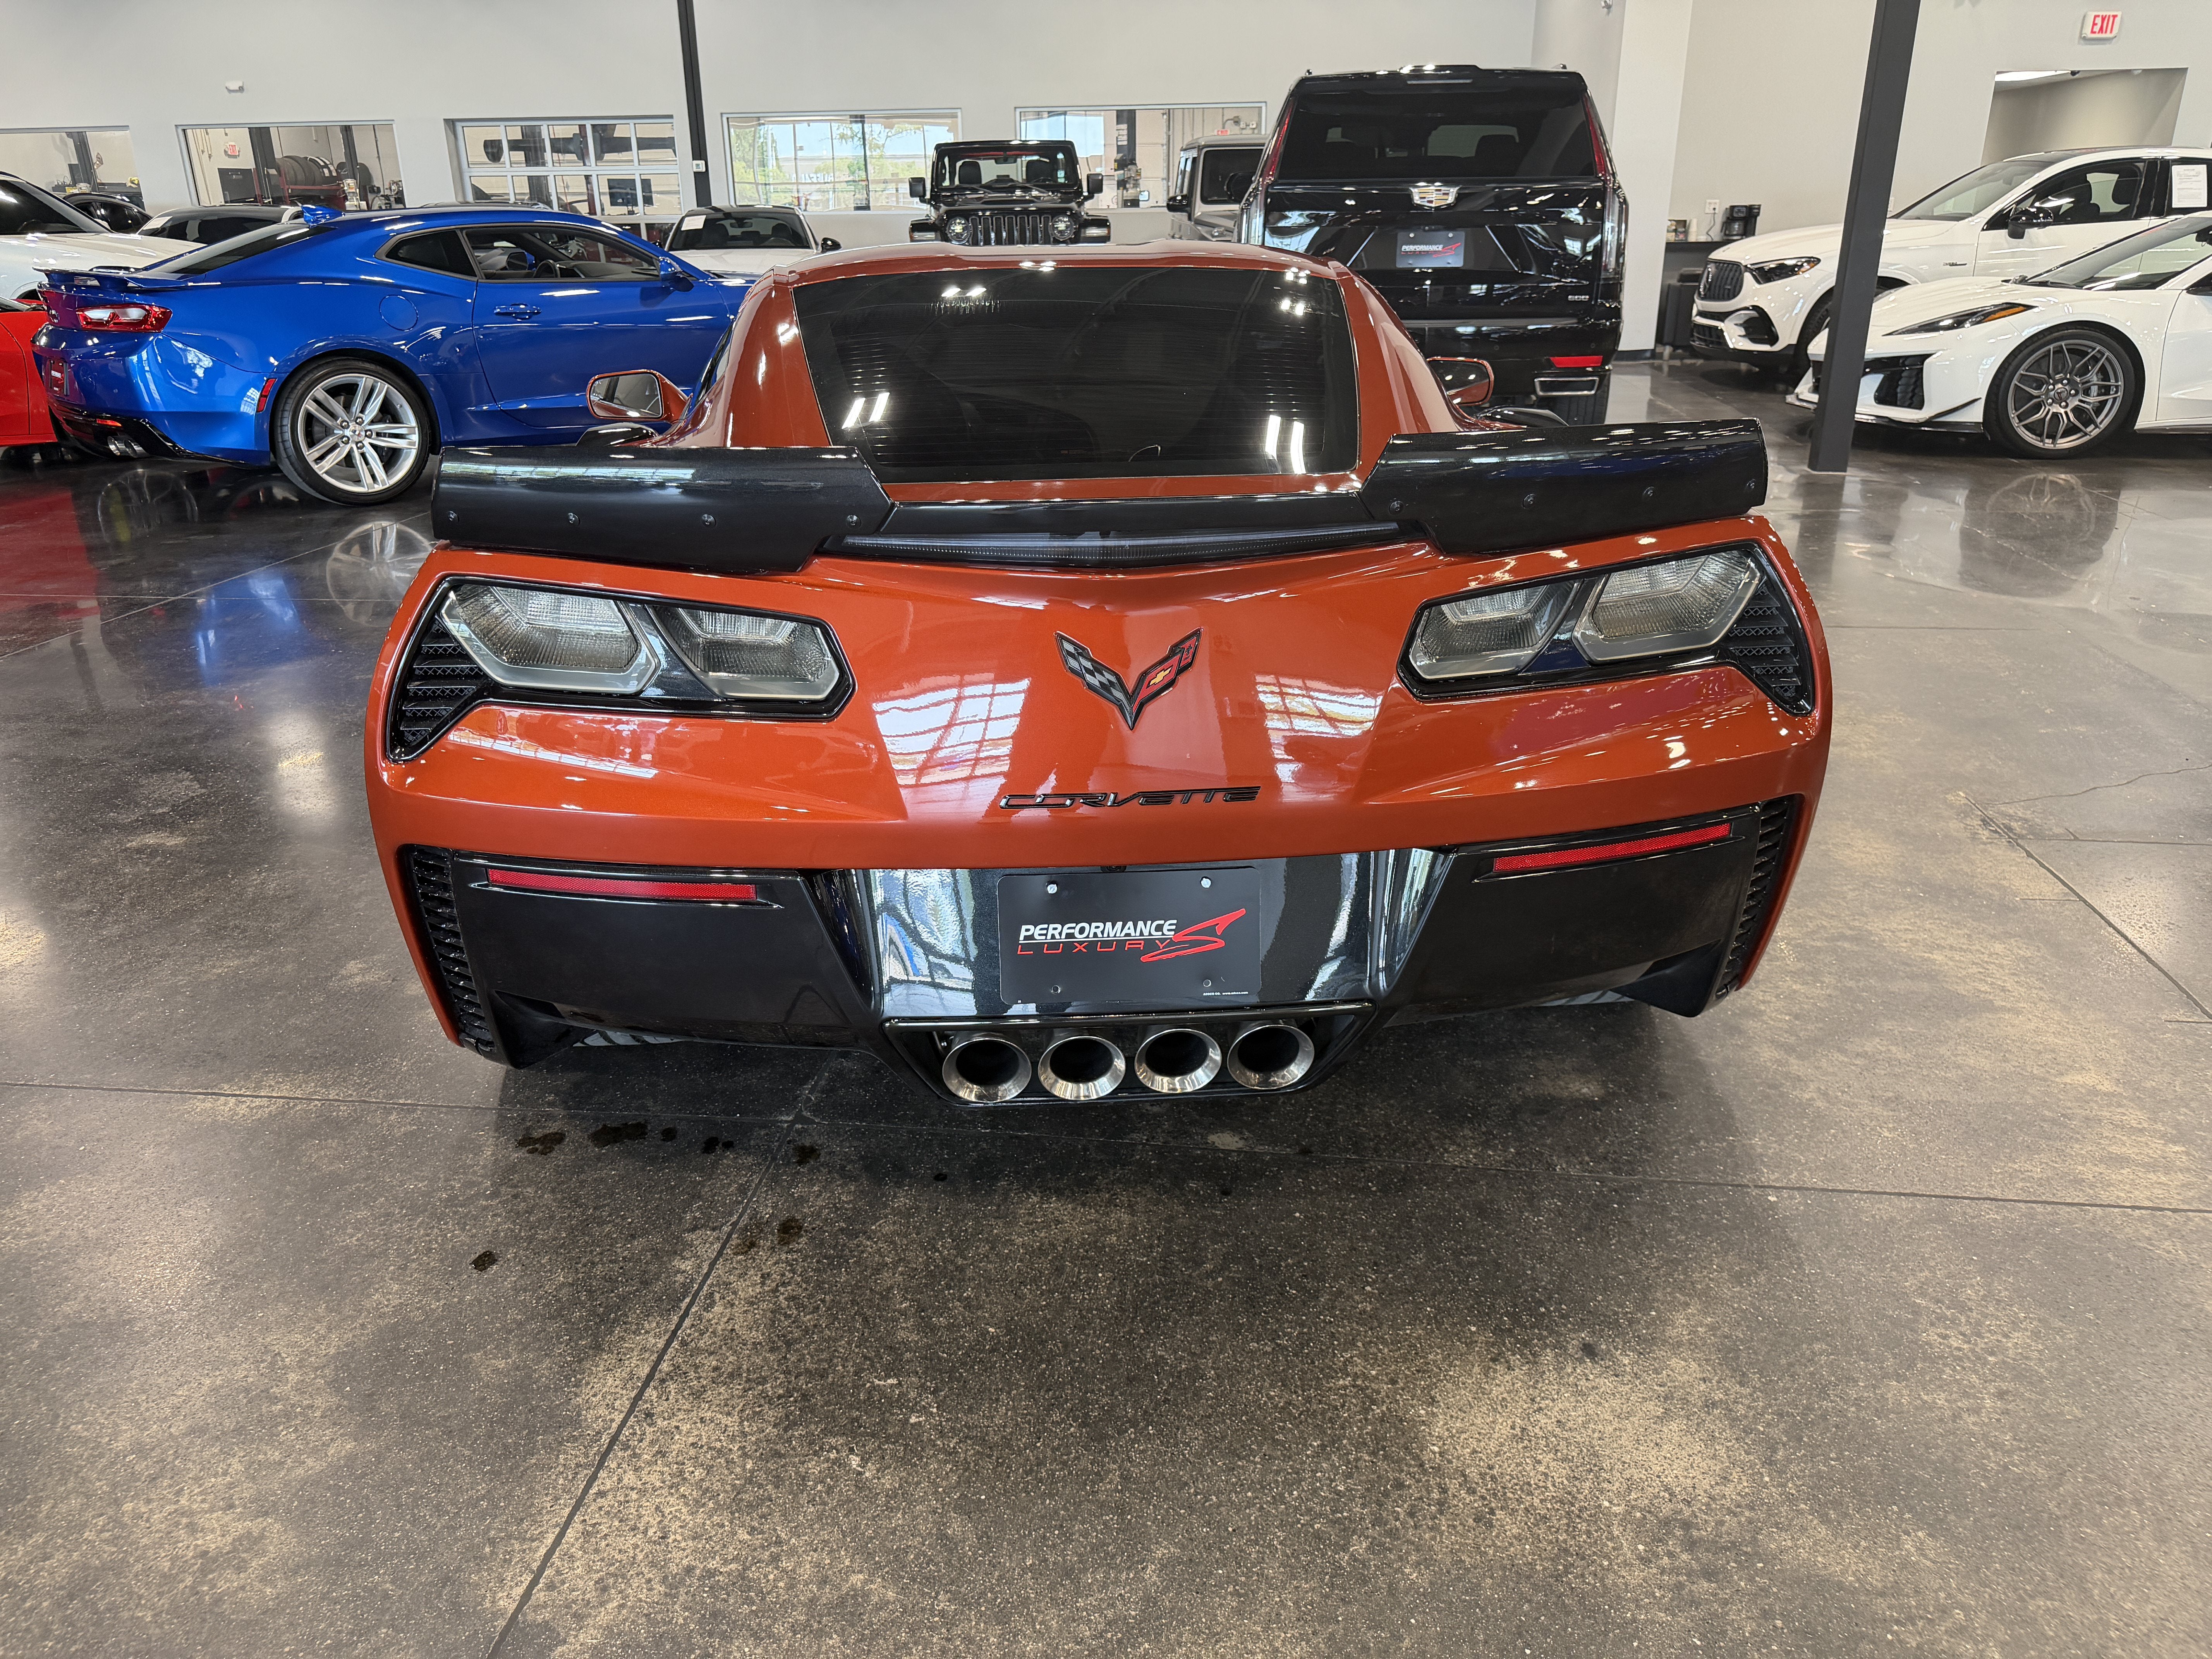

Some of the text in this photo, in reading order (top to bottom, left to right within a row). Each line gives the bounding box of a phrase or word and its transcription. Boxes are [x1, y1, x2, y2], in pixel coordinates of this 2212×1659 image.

[2090, 14, 2118, 34] EXIT
[999, 786, 1261, 809] CORVETTE
[1019, 919, 1177, 941] PERFORMANCE
[1017, 939, 1171, 955] LUXURY
